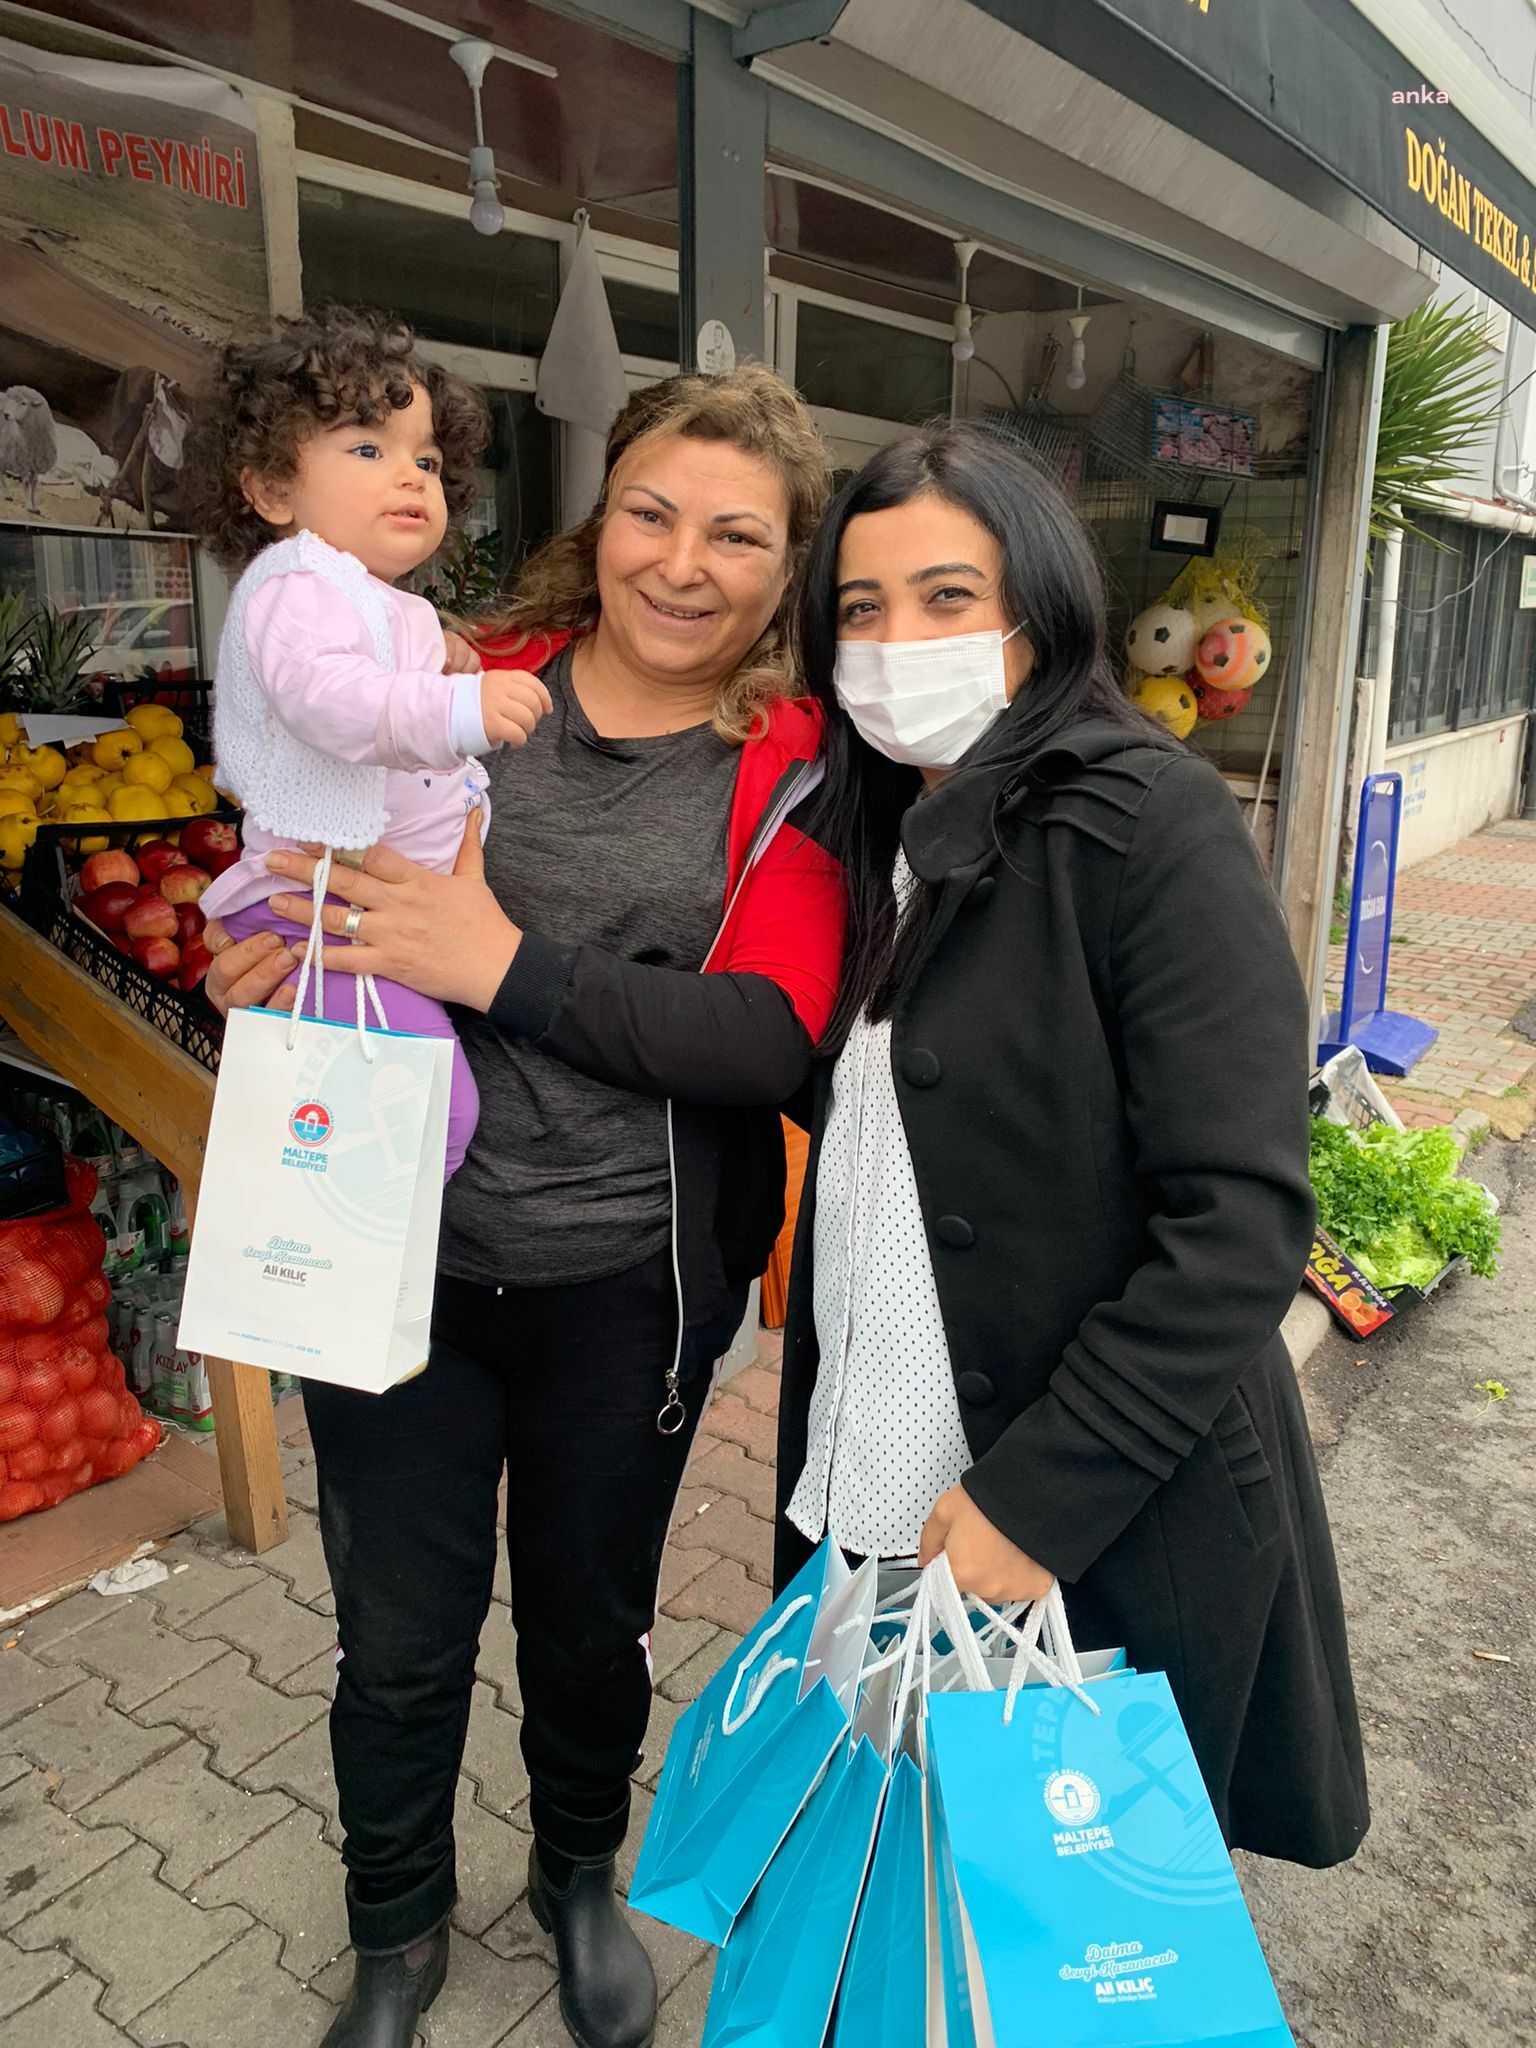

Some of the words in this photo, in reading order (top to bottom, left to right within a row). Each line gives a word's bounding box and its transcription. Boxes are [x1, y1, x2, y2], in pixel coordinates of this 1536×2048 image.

[97, 127, 247, 208] PEYNİRİ
[1405, 126, 1471, 235] DOĞAN
[1473, 186, 1520, 277] TEKEL
[1520, 233, 1532, 288] &
[281, 1157, 328, 1173] BELEDİYESİ
[283, 1146, 329, 1164] MALTEPE
[263, 1264, 279, 1276] Ali
[279, 1267, 308, 1283] KILIÇ
[1053, 1825, 1112, 1846] MALTEPE
[1056, 1836, 1115, 1857] BELEDİYESİ
[1085, 1940, 1143, 1963] Daima
[1059, 1963, 1098, 1982] Sevgi
[1098, 1948, 1179, 1979] Kazanacak
[1095, 1981, 1115, 1997] Ali
[1115, 1976, 1155, 1994] KILIÇ
